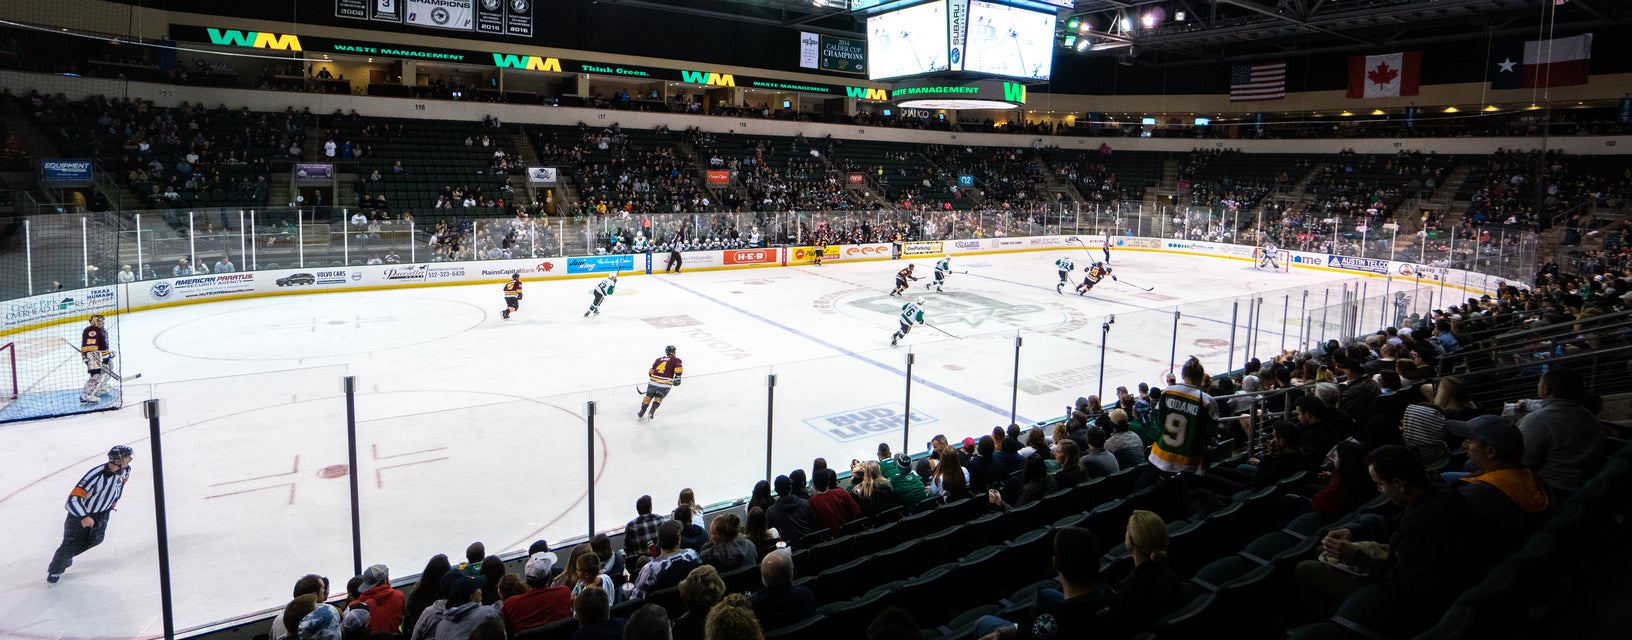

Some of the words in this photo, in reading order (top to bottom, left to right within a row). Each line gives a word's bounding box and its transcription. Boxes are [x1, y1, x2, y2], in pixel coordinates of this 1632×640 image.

[206, 28, 302, 51] WM
[334, 44, 377, 54] WASTE
[380, 48, 464, 60] MANAGEMENT
[824, 49, 864, 60] CHAMPIONS
[492, 53, 562, 72] WM
[582, 64, 613, 74] Think
[616, 67, 650, 76] Green.
[682, 70, 735, 87] WM
[780, 84, 830, 92] MANAGEMENT
[846, 86, 887, 100] WM
[579, 263, 595, 271] King
[1341, 257, 1367, 266] AUSTIN
[1368, 259, 1389, 269] TELCO
[175, 276, 216, 286] AMERICAN
[216, 274, 253, 282] PARATUS
[11, 302, 37, 312] Cedar
[40, 298, 57, 306] Park
[6, 305, 50, 320] OVERHEAD
[656, 361, 667, 374] 4
[826, 408, 896, 426] BUD
[830, 412, 922, 438] LIGHT
[1163, 412, 1187, 448] 9
